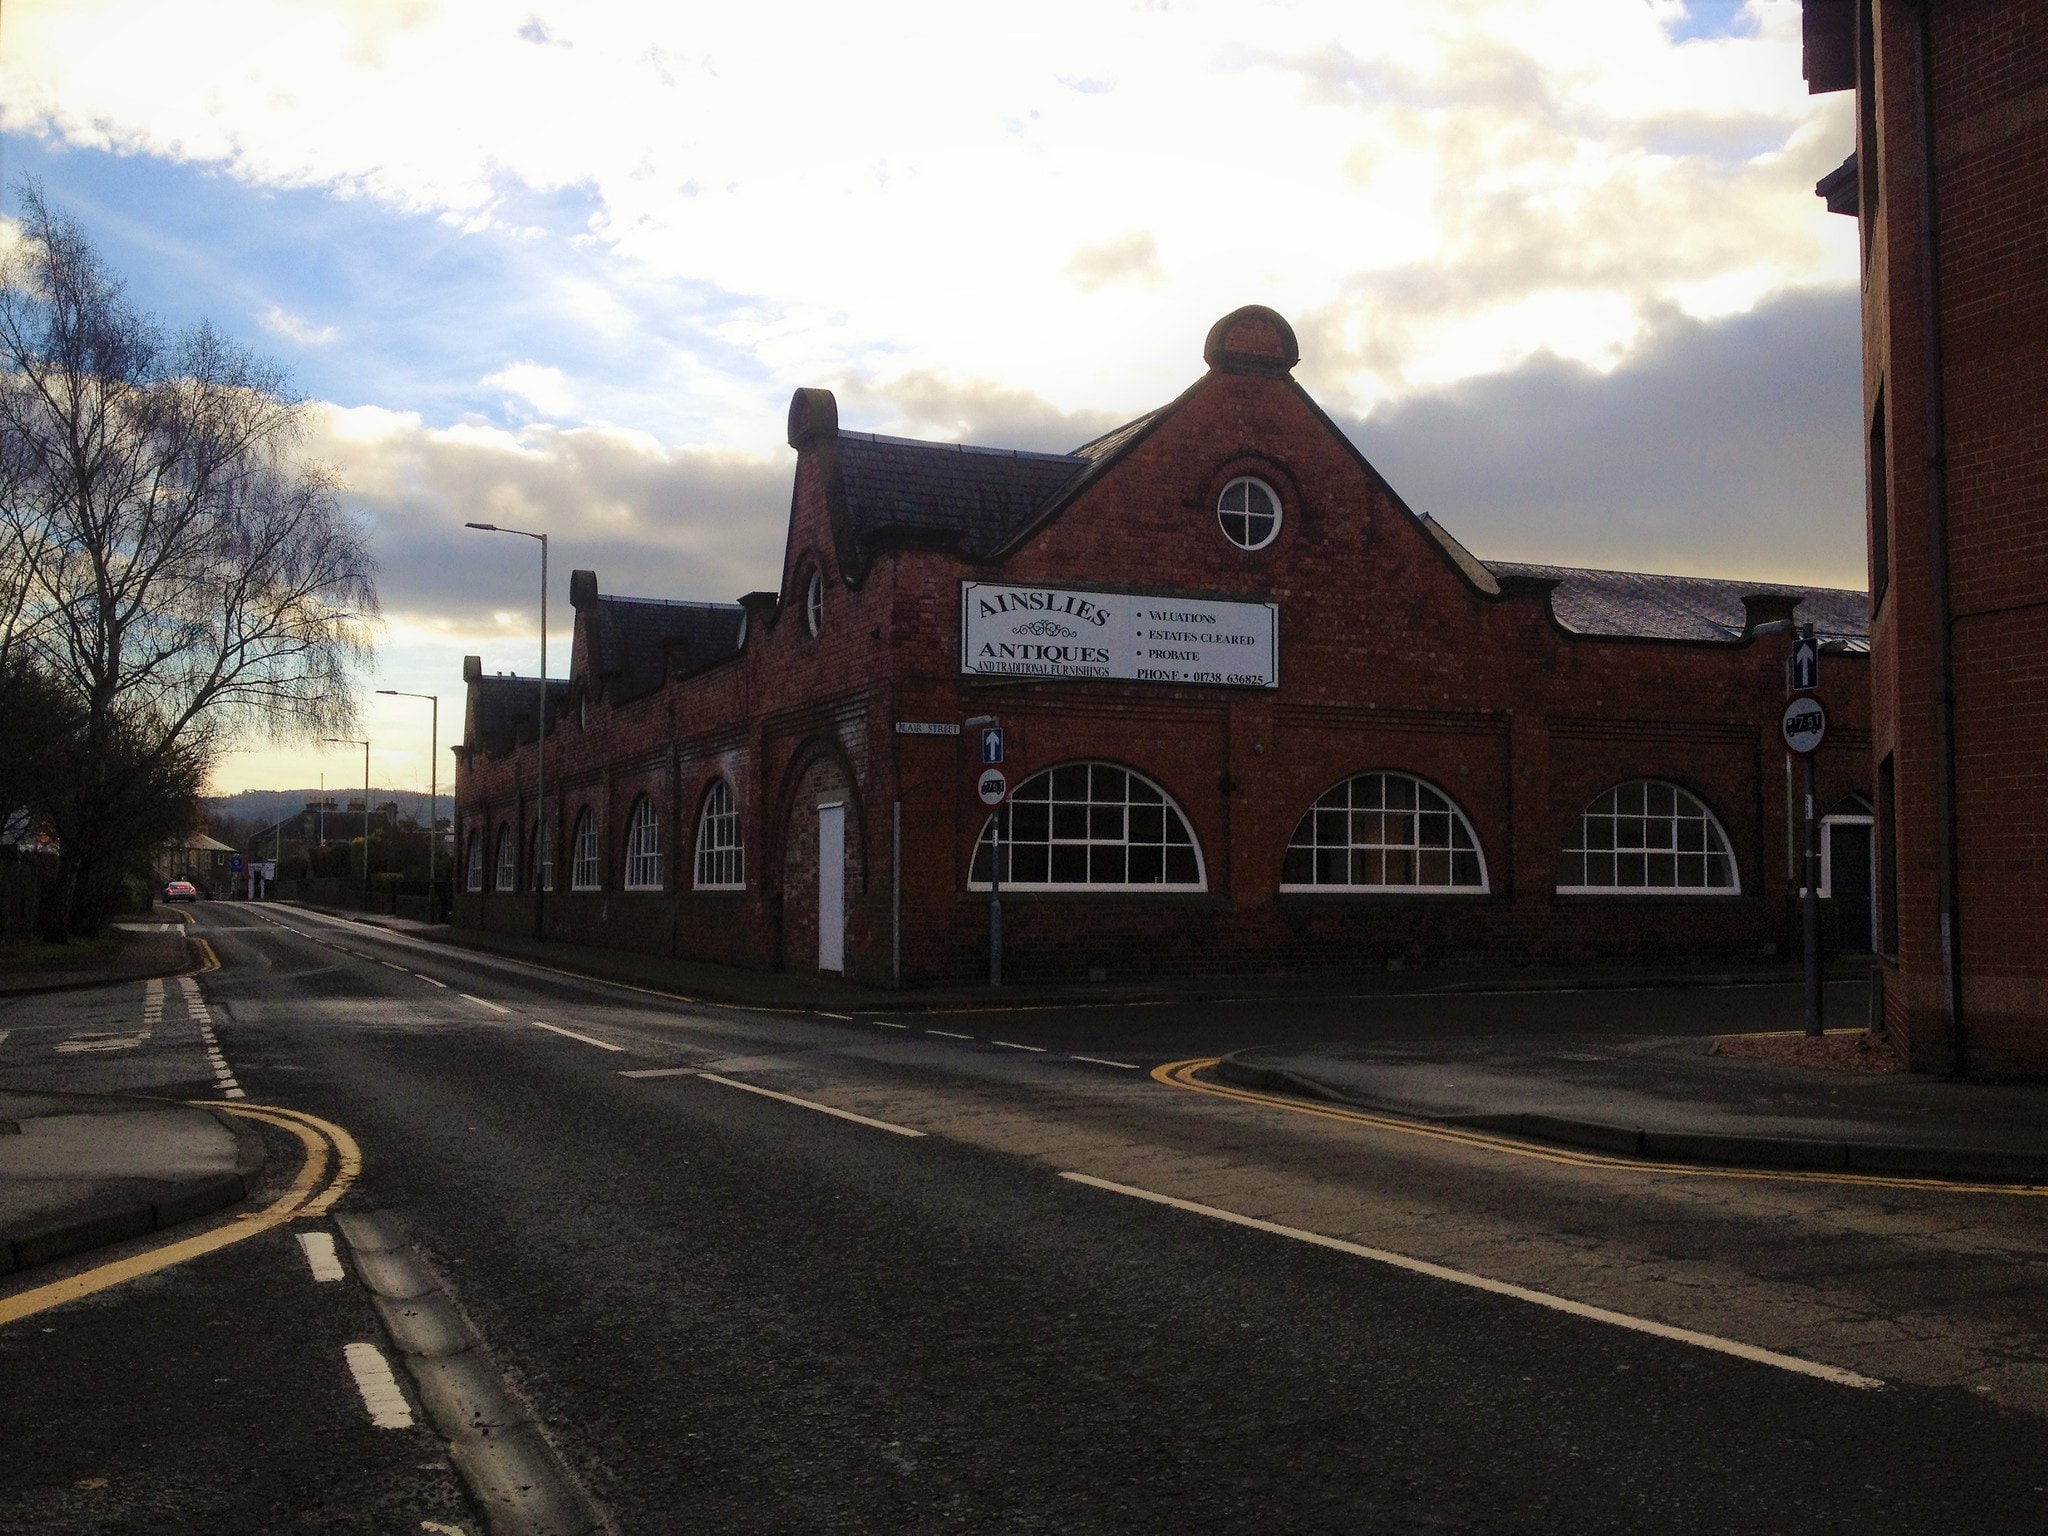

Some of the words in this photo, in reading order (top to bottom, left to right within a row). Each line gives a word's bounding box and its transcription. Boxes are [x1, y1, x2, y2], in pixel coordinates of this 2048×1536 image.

[979, 592, 1111, 627] AINSLIES
[1149, 611, 1216, 624] VALUATIONS
[1149, 630, 1198, 642] ESTATES
[1200, 633, 1255, 646] CLEARED
[979, 642, 1110, 664] ANTIQUES
[1148, 649, 1199, 661] PROBATE
[977, 660, 995, 671] AND
[997, 661, 1049, 675] TRADITIONAL
[1051, 664, 1110, 677] FURNISHINGS
[1137, 669, 1180, 681] PHONE
[1193, 671, 1222, 683] 01738
[1227, 673, 1263, 685] 636825
[927, 724, 958, 734] STREET
